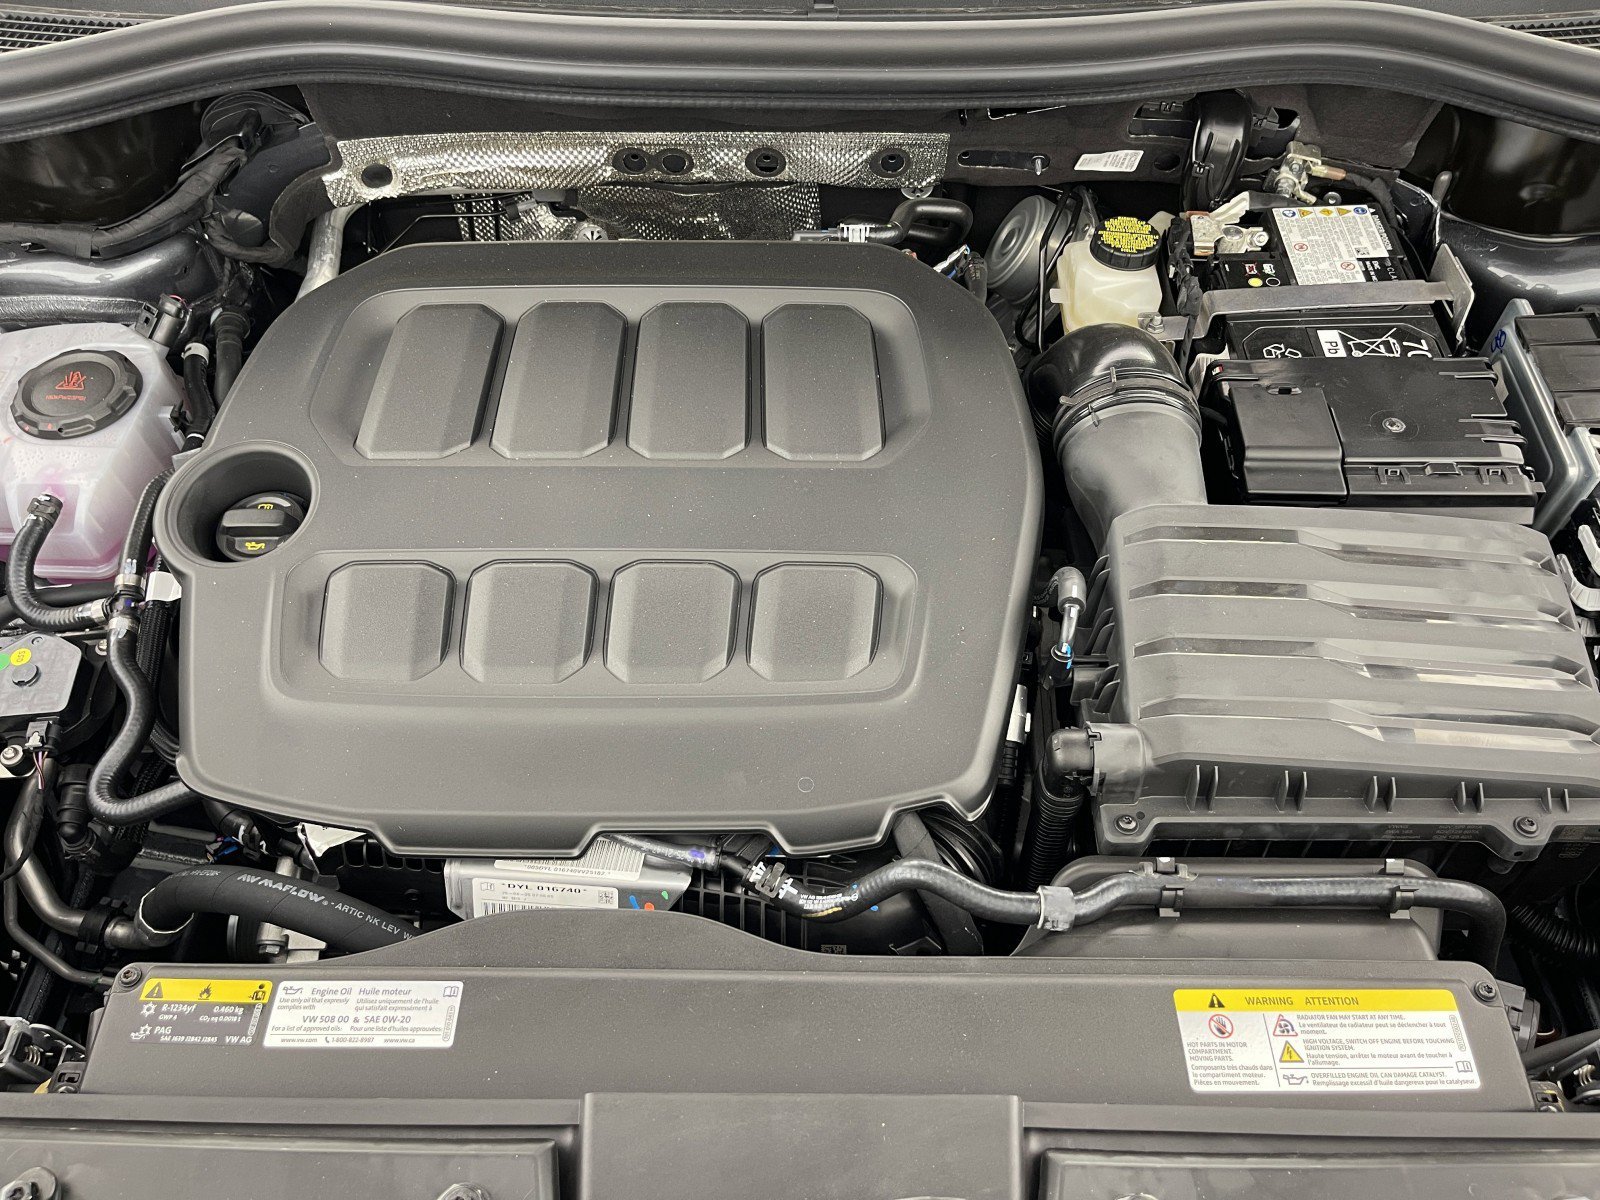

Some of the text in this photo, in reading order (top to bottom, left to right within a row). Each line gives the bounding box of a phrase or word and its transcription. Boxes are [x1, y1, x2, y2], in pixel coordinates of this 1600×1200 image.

[1325, 340, 1340, 355] Pb
[335, 903, 364, 919] ARTIC
[366, 915, 380, 926] NK
[382, 921, 400, 934] LEV
[311, 988, 339, 997] Engine
[1244, 997, 1359, 1005] WARNING ATTENTION
[161, 1004, 197, 1014] R-1234yf
[234, 1006, 244, 1015] kg
